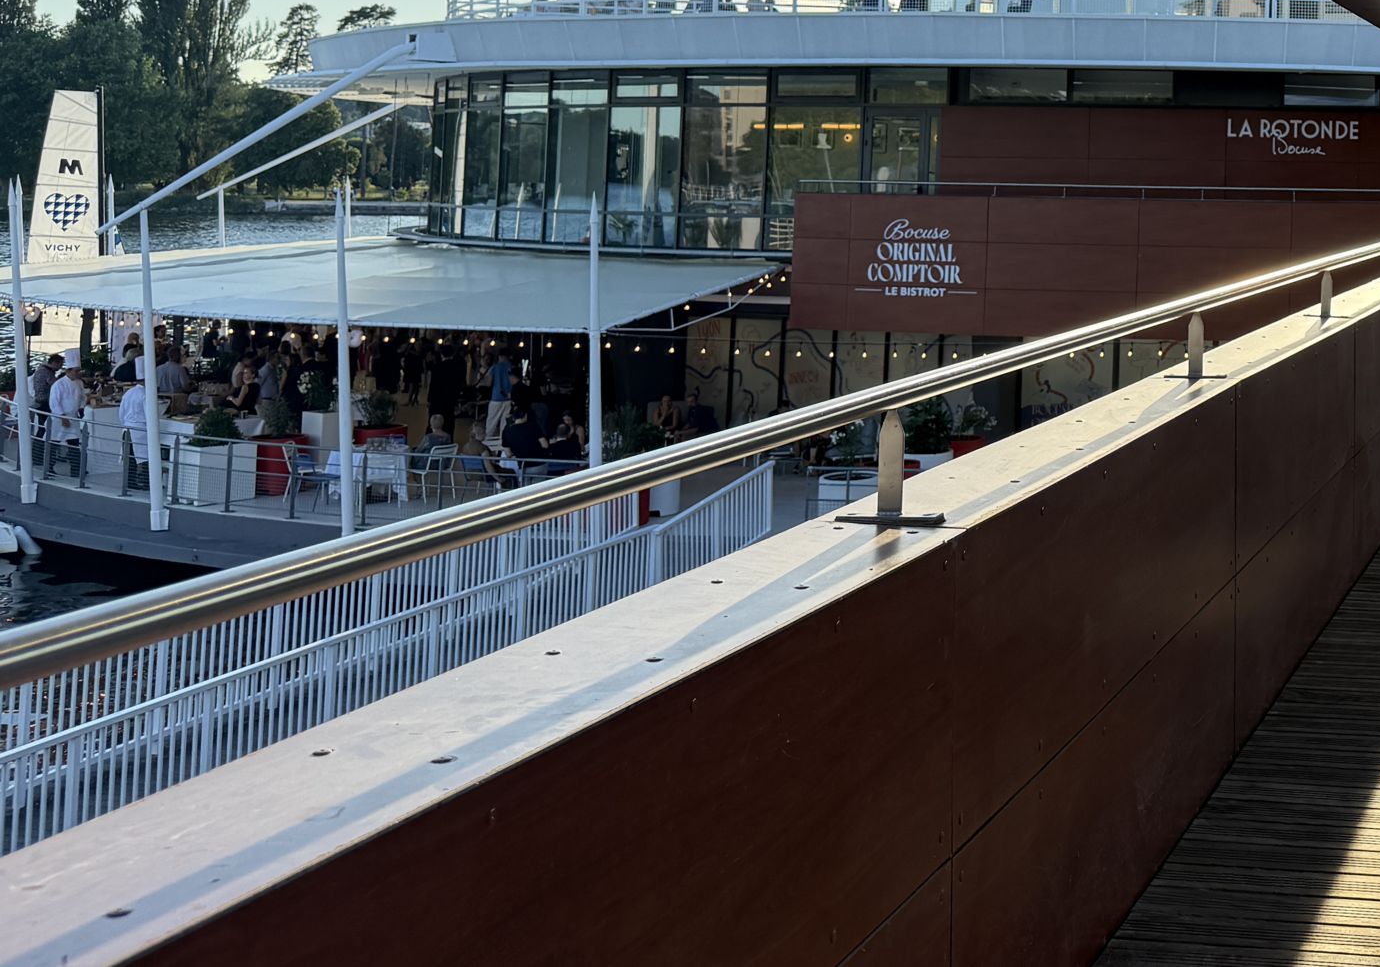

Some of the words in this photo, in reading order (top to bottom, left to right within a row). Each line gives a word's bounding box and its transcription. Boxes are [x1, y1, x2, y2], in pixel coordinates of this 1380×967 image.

[1227, 118, 1253, 138] LA
[1260, 119, 1359, 140] ROTONDE
[1270, 129, 1326, 155] Bocuse
[883, 218, 950, 240] Bocuse
[44, 244, 81, 252] VICHY
[876, 241, 957, 262] ORIGINAL
[867, 262, 963, 284] COMPTOIR
[884, 286, 898, 296] LE
[900, 287, 946, 297] BISTROT
